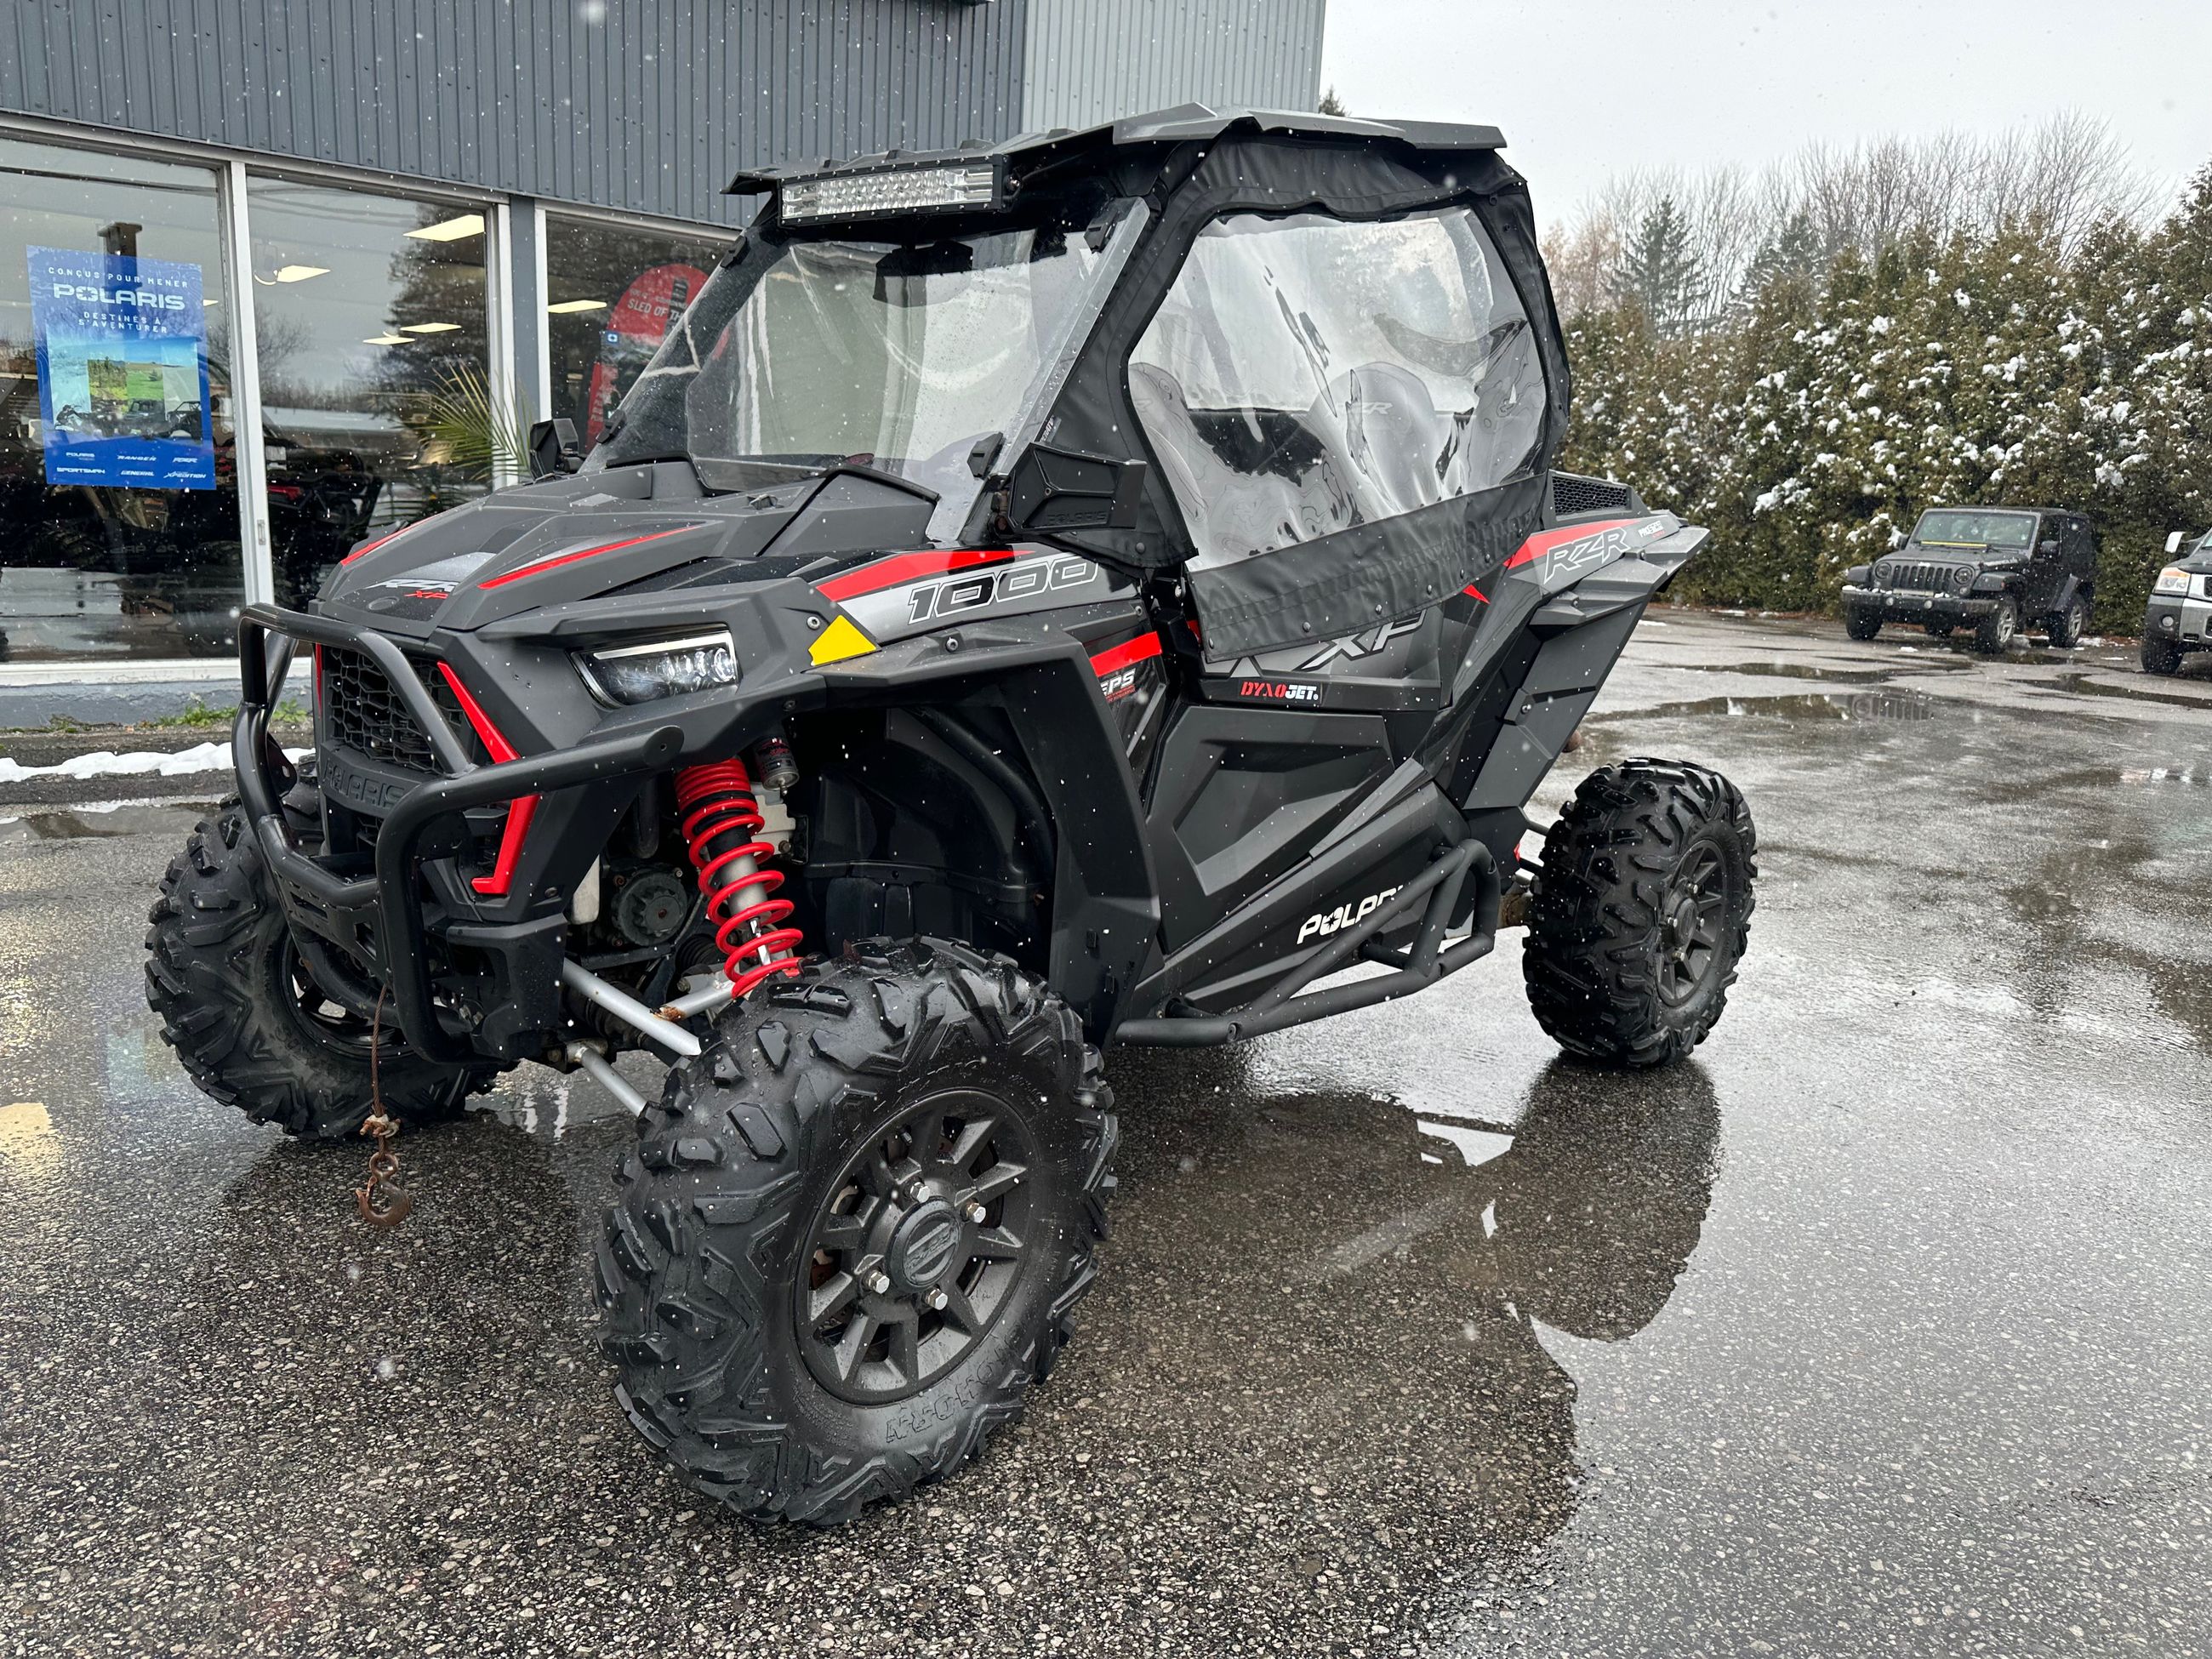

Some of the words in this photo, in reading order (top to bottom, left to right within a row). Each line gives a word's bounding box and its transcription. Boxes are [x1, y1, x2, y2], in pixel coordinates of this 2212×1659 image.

[53, 282, 185, 311] POLARIS
[107, 273, 140, 283] POUR
[147, 277, 188, 288] MENER
[627, 298, 652, 314] SLED
[653, 306, 669, 317] OF
[1543, 527, 1631, 584] RZR
[908, 554, 1098, 625] 1000
[1297, 884, 1404, 945] POLA
